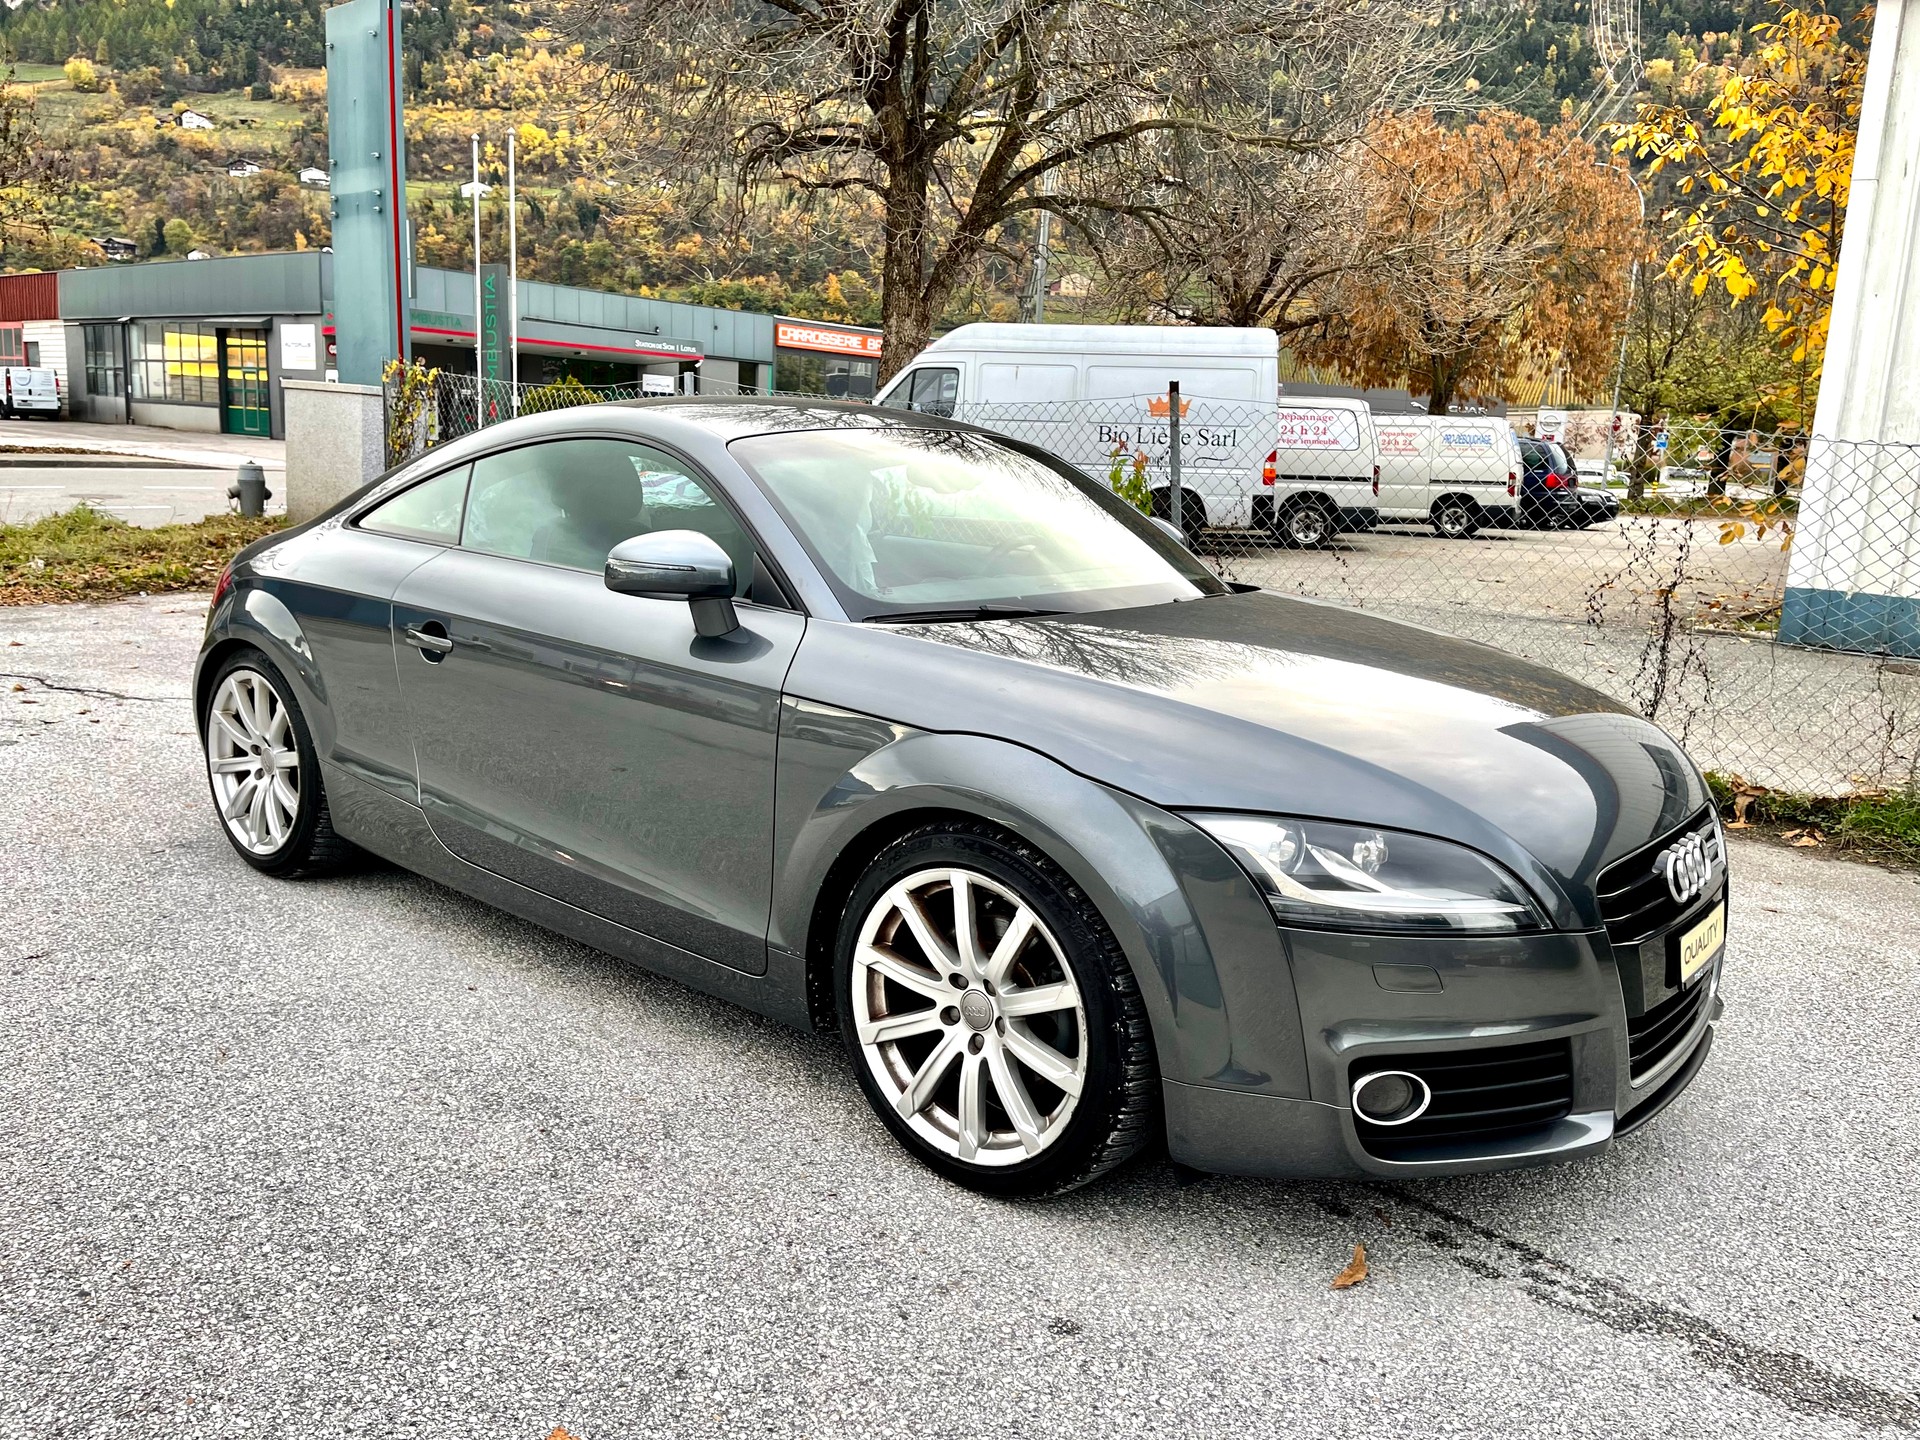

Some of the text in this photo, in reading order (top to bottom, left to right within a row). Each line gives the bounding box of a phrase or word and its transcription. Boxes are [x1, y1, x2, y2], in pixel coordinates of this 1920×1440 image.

[411, 312, 462, 329] MBUSTIA
[484, 272, 499, 390] MBUSTIA
[779, 327, 862, 348] CARROSSERIE
[1277, 412, 1335, 423] Dépannage
[1448, 405, 1488, 415] GUAR
[1098, 426, 1238, 447] Bio Lièe Sarl
[1281, 425, 1327, 436] 24 h 24
[1684, 919, 1719, 965] QUALITY
